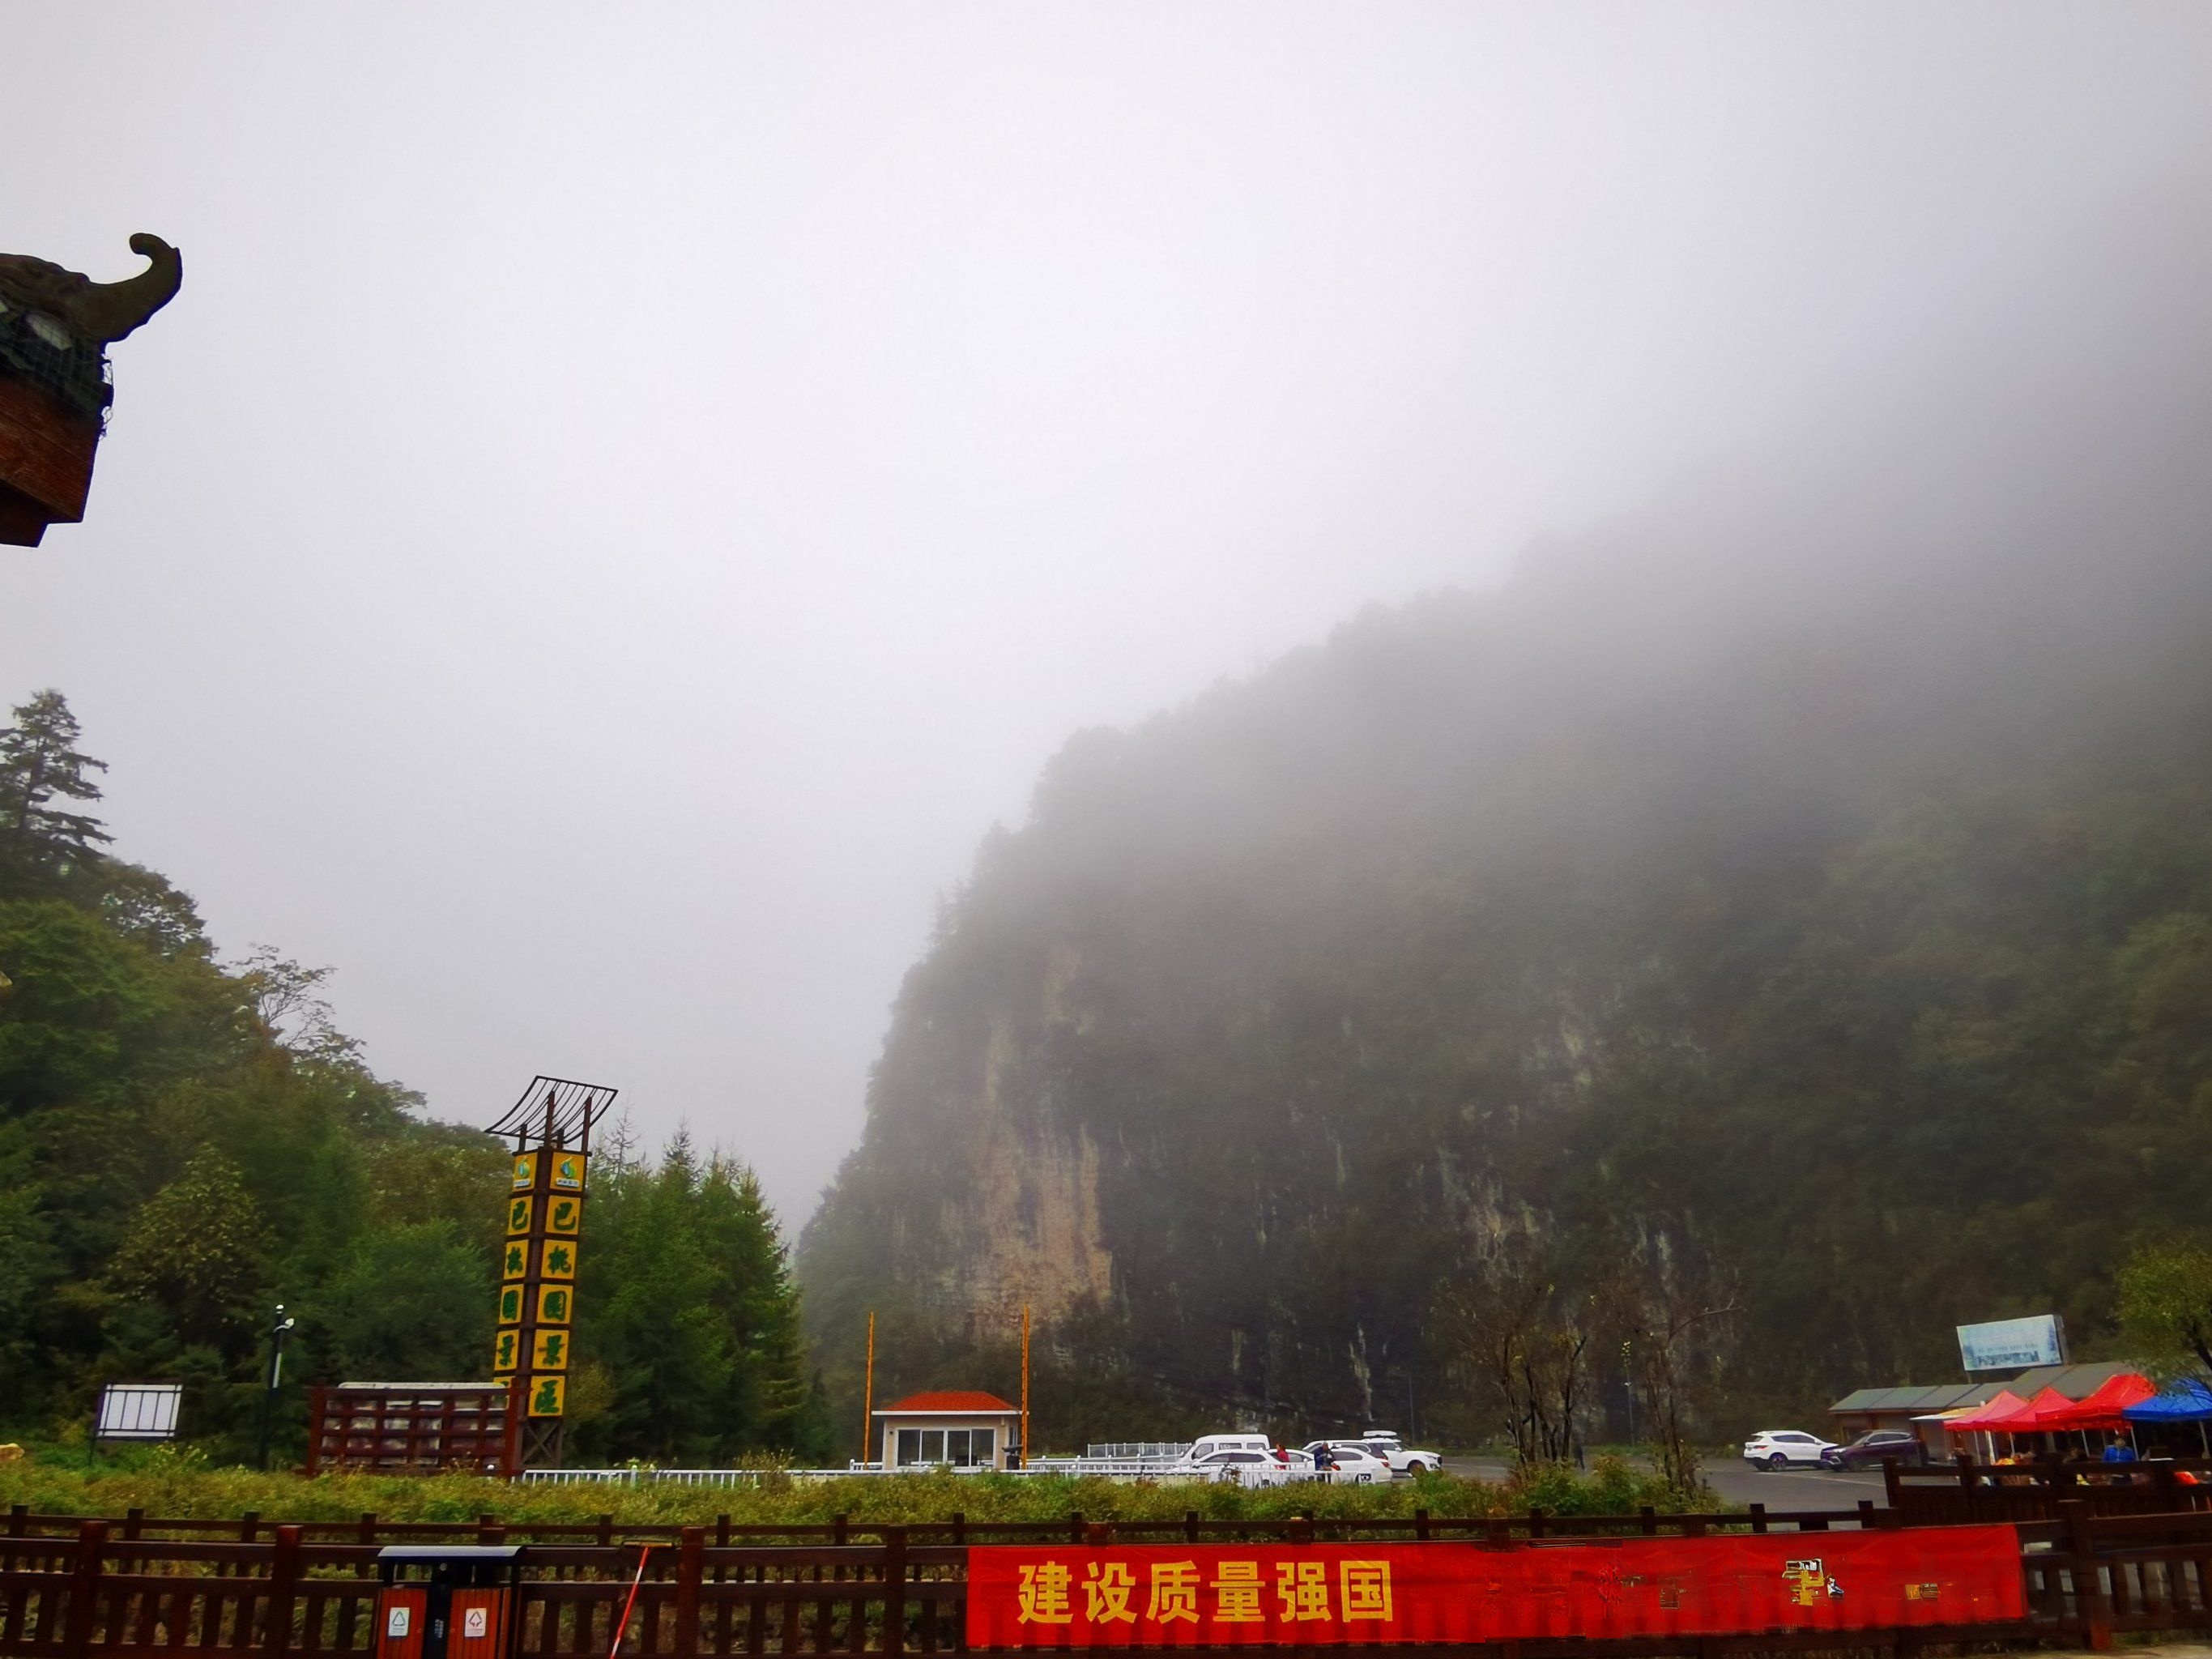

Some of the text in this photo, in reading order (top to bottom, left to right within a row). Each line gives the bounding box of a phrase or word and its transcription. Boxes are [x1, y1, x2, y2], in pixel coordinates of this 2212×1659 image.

[497, 1201, 528, 1405] 巴桃園景
[1017, 1560, 1393, 1624] 建设质量强国
